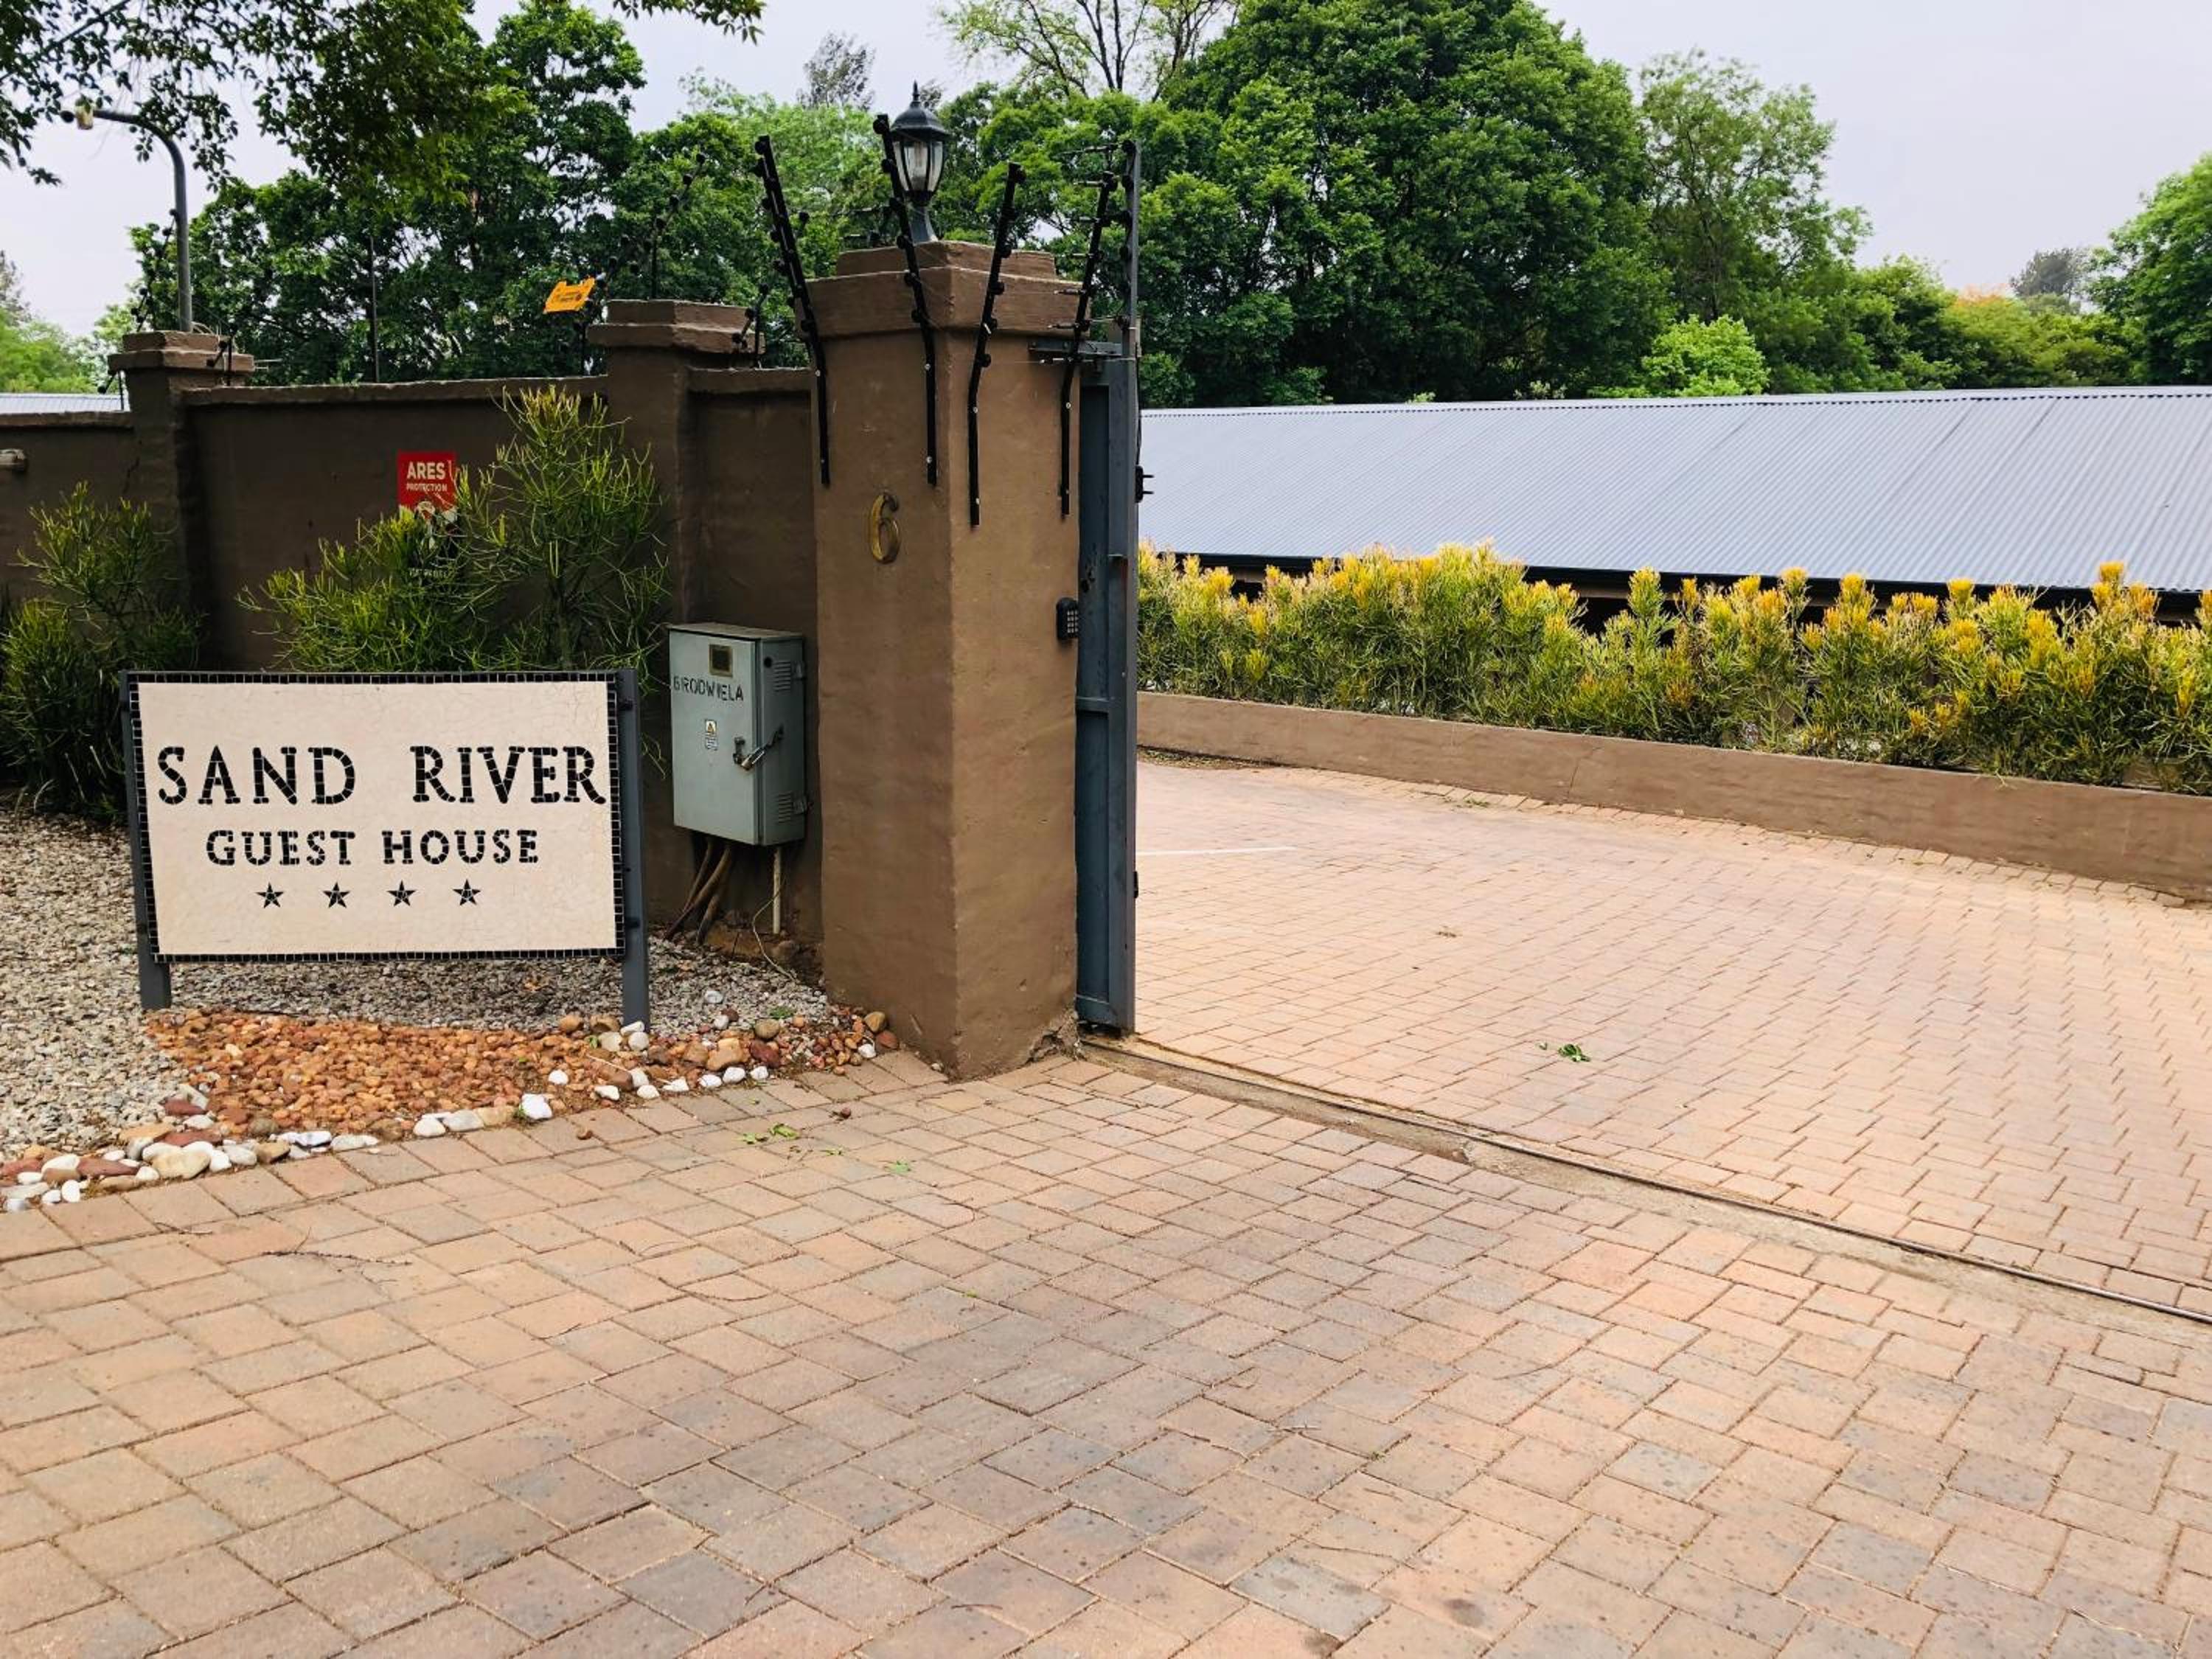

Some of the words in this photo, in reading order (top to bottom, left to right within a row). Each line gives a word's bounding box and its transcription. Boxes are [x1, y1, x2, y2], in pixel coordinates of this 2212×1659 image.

[406, 461, 446, 480] ARES
[406, 483, 448, 492] PROTECTION
[159, 747, 355, 805] SAND
[411, 747, 607, 804] RIVER
[207, 831, 355, 866] GUEST
[383, 830, 538, 865] HOUSE
